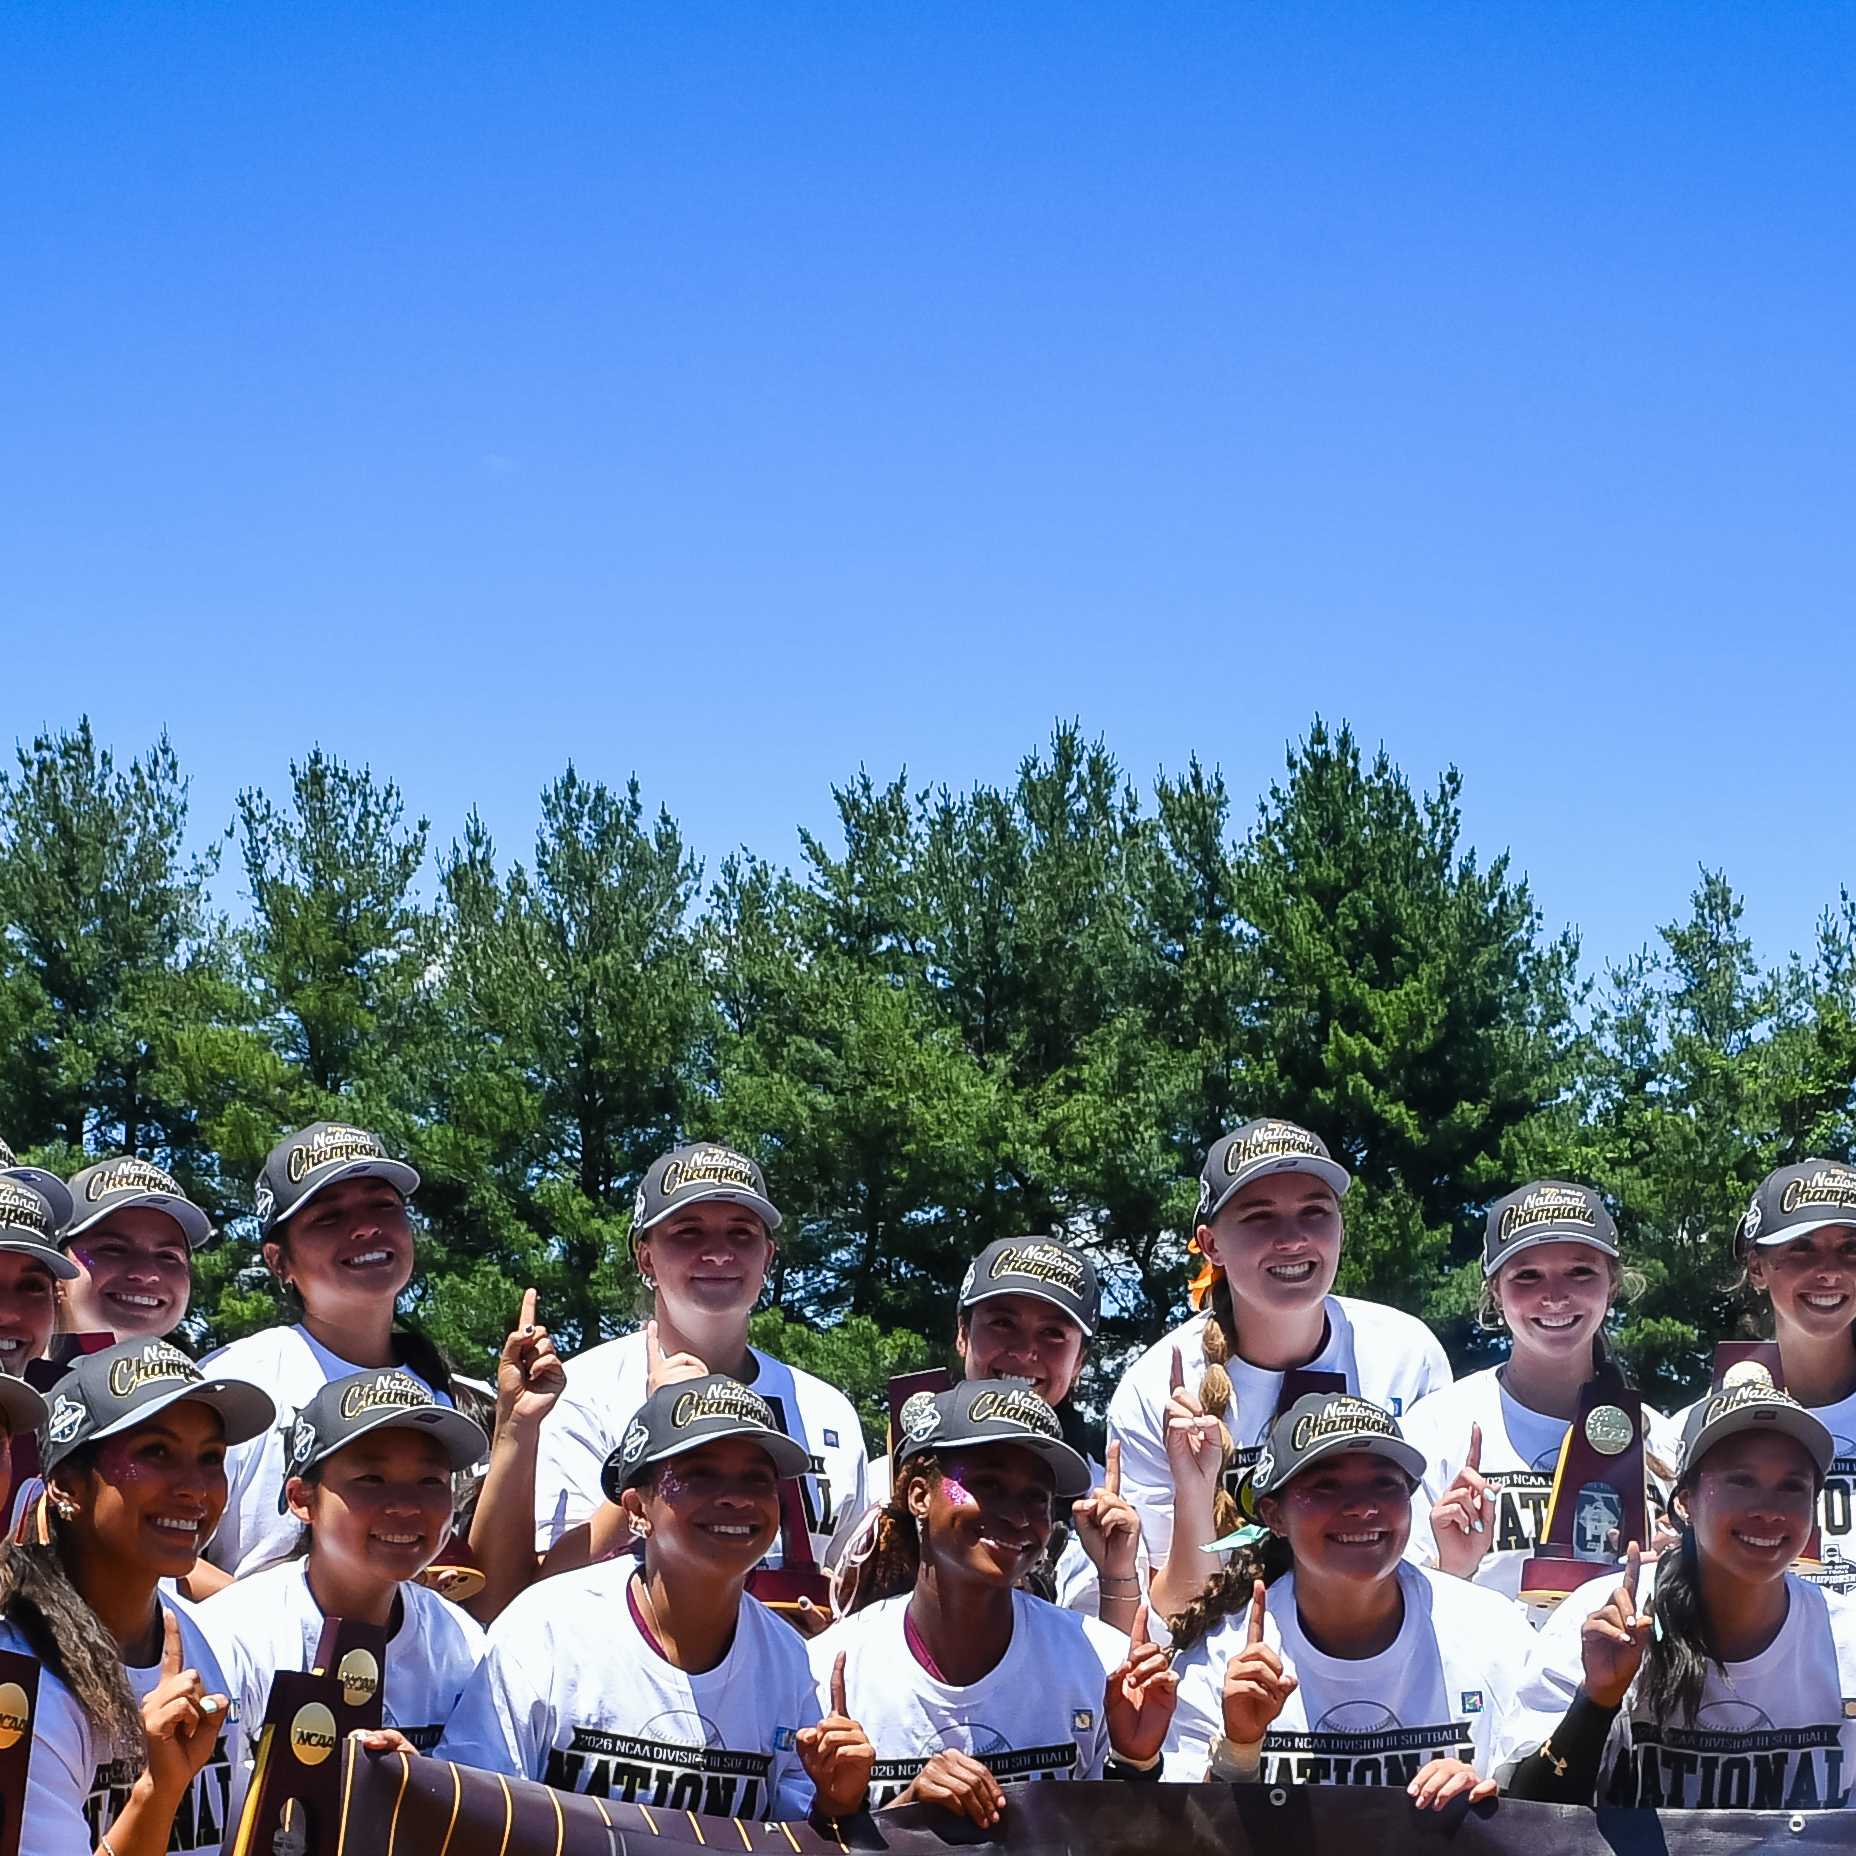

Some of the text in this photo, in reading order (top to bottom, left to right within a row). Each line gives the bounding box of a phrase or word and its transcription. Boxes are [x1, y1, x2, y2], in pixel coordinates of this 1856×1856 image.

[313, 1133, 374, 1149] National
[1253, 1126, 1311, 1142] National
[694, 1152, 751, 1172] National
[1524, 1193, 1586, 1207] National
[1499, 1206, 1596, 1240] Champions
[1024, 1244, 1084, 1276] National
[1324, 1400, 1387, 1420] National
[1513, 1474, 1546, 1486] NCAA
[297, 1730, 336, 1748] NCAA
[579, 1734, 613, 1751] 2026
[615, 1739, 652, 1758] NCAA
[1265, 1728, 1462, 1750] 026 NCAA DIVISION III SOFTBALL
[1699, 1736, 1753, 1748] DIVISION
[1756, 1735, 1769, 1747] III
[1772, 1730, 1829, 1745] SOFTBALL
[1011, 1750, 1070, 1768] SOFTBALL
[871, 1765, 895, 1777] 026
